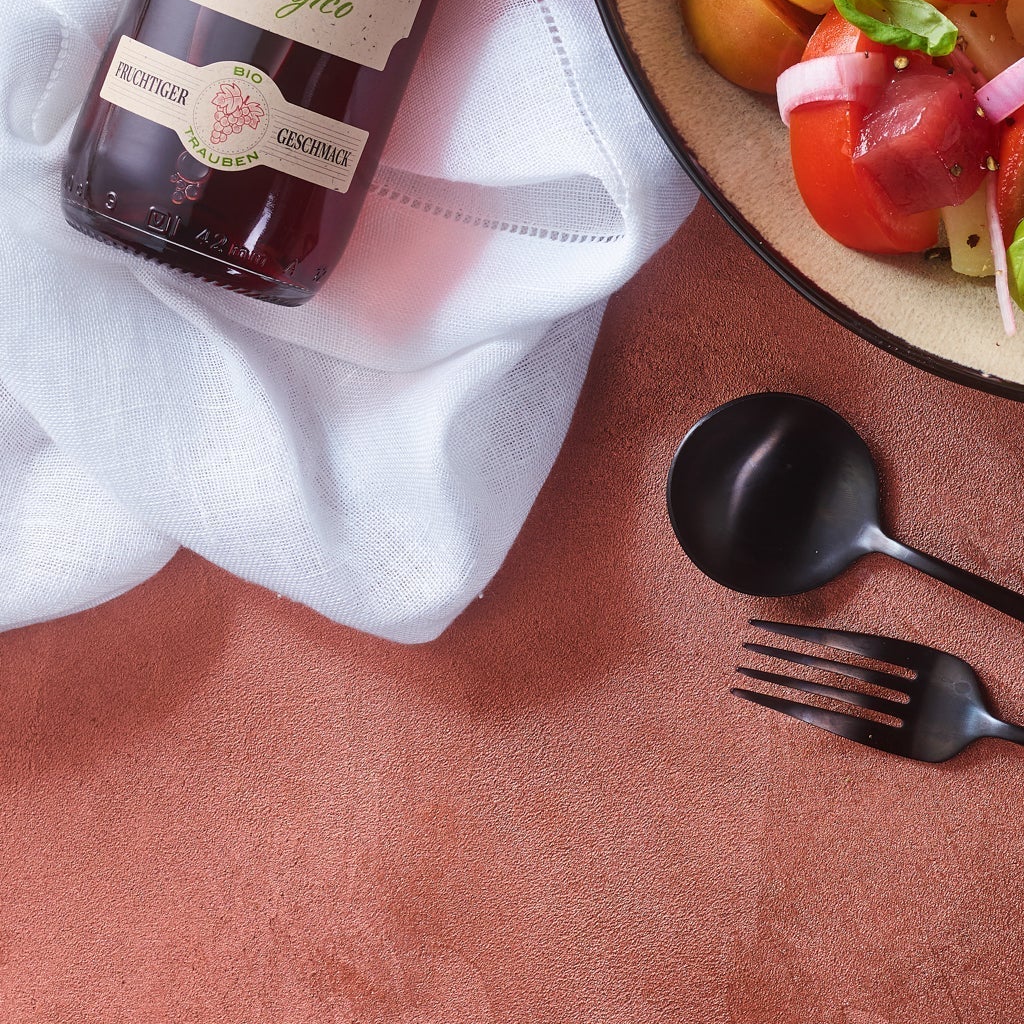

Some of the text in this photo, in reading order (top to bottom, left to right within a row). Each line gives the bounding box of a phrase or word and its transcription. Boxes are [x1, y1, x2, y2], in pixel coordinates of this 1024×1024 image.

[115, 60, 189, 107] FRUCHTIGER
[233, 65, 263, 85] BIO
[183, 126, 260, 168] TRAUBEN
[276, 127, 352, 168] GESCHMACK
